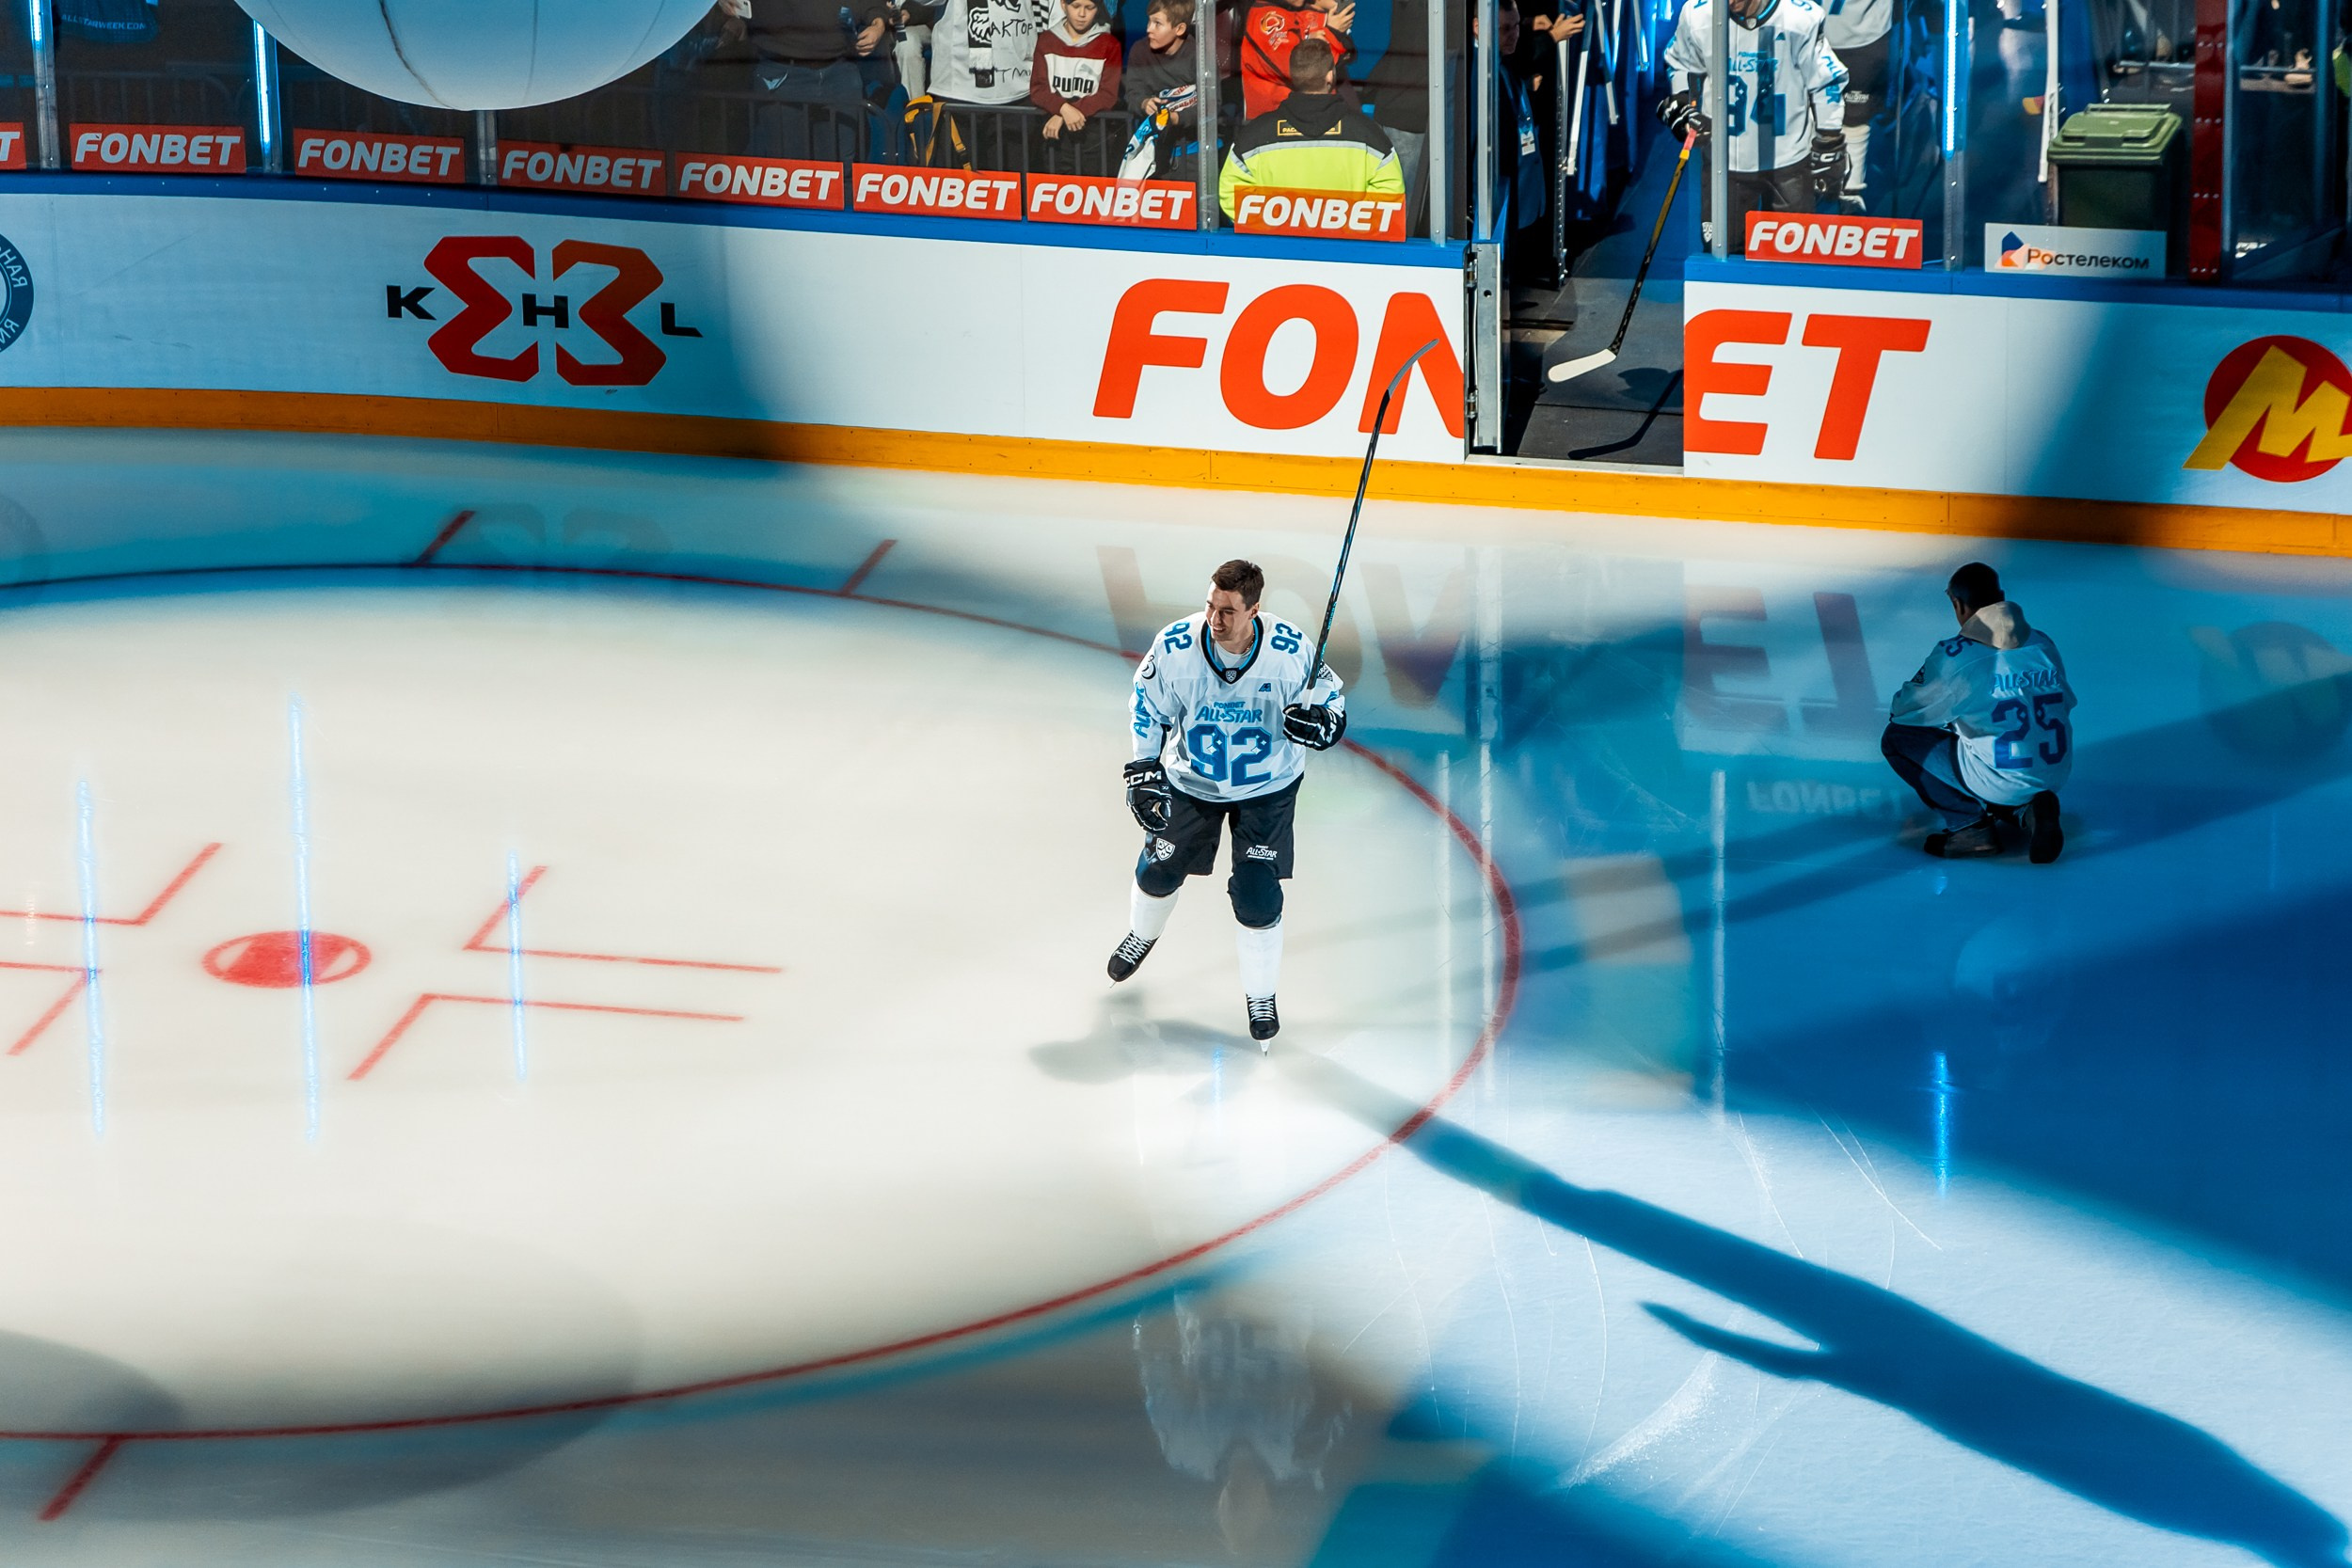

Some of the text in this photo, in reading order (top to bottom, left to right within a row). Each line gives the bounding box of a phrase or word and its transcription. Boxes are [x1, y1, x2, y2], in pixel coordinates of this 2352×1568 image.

[1052, 75, 1095, 94] PUMA
[74, 133, 241, 166] FONBET
[298, 138, 461, 176] FONBET
[501, 150, 662, 189] FONBET
[679, 162, 840, 200] FONBET
[856, 173, 1017, 211] FONBET
[1030, 183, 1193, 220] FONBET
[1237, 194, 1403, 232] FONBET
[1748, 221, 1919, 260] FONBET
[2026, 248, 2150, 270] Ростелеком
[1270, 623, 1303, 655] 92
[1991, 691, 2068, 768] 25
[1186, 723, 1272, 787] 92
